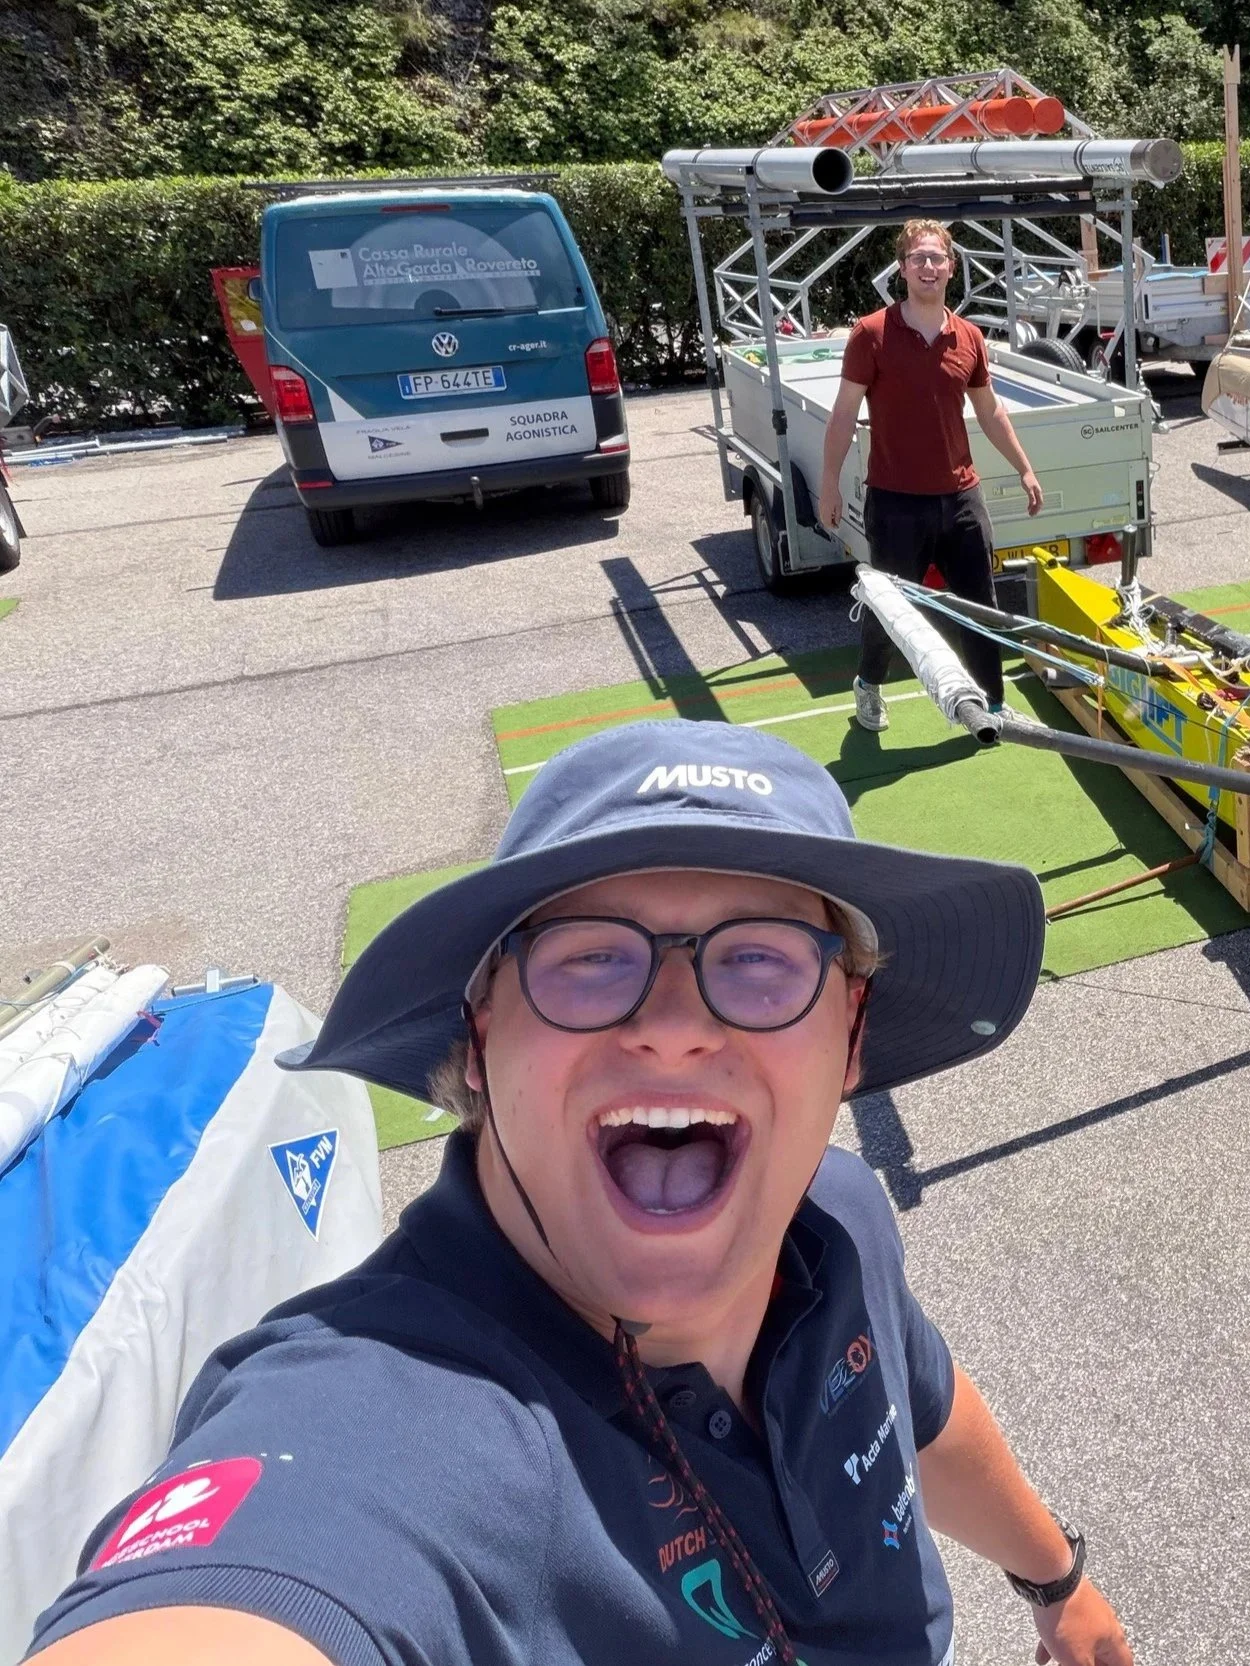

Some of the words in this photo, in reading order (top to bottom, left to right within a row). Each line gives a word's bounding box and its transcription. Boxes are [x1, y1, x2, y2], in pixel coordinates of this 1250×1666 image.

[358, 247, 409, 262] Cassa
[413, 242, 468, 259] Rurale
[465, 257, 538, 272] Rovereto
[508, 340, 548, 352] cr-ager.it
[509, 410, 569, 426] SQUADRA
[1094, 423, 1139, 433] SAILCENTER
[505, 424, 579, 443] AGONISTICA
[636, 764, 773, 796] MUSTO
[309, 1134, 333, 1170] FVN
[861, 1440, 881, 1472] Acta
[877, 1403, 897, 1441] Marine
[658, 1525, 706, 1574] DUTCH
[815, 1558, 834, 1586] MUSTO
